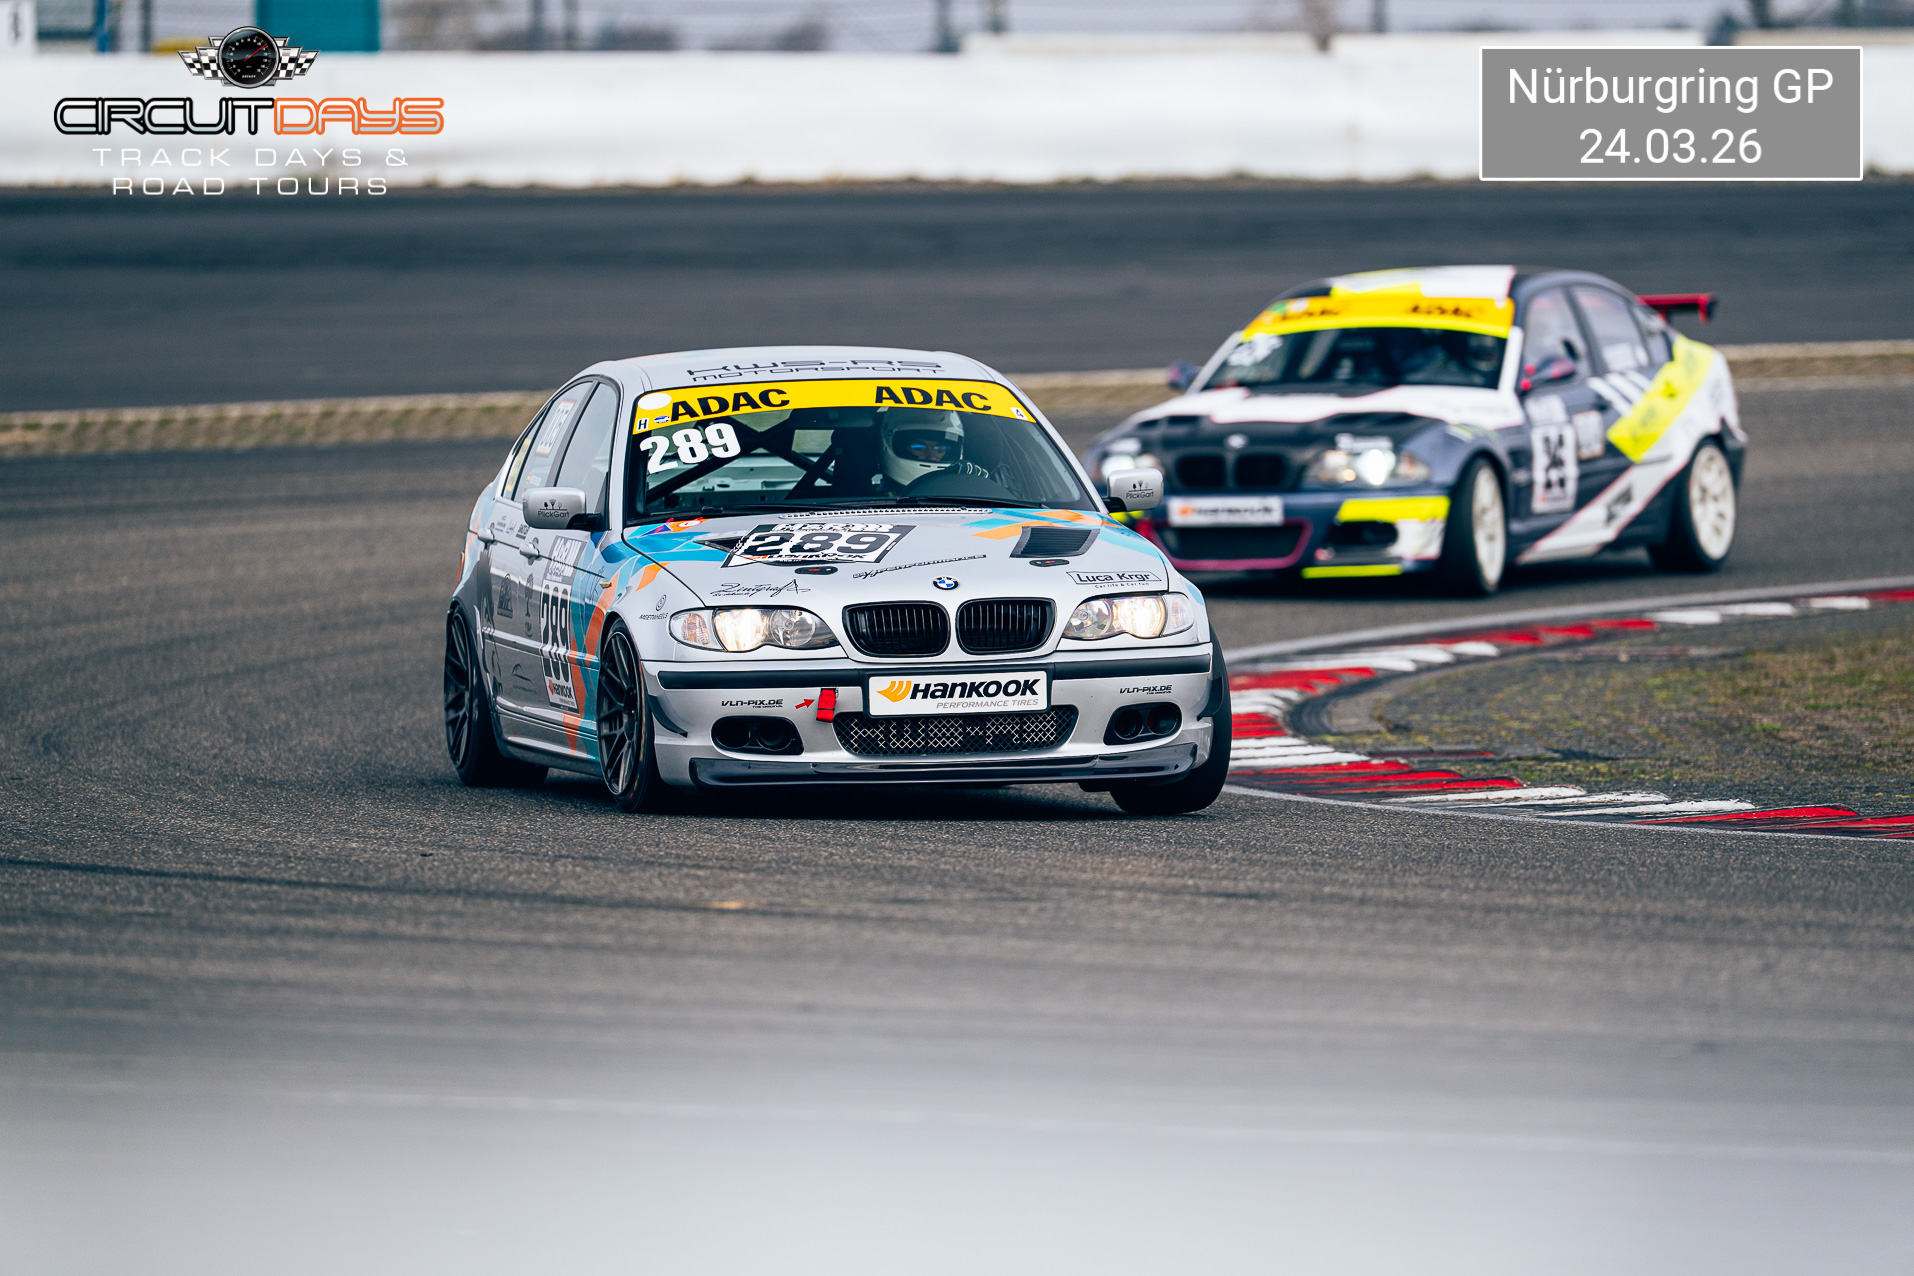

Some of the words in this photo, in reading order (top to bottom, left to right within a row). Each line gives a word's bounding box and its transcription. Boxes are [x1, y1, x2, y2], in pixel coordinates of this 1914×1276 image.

[693, 366, 946, 382] MOTORSPORT
[671, 388, 790, 423] ADAC
[874, 386, 992, 411] ADAC
[638, 418, 648, 430] H
[640, 423, 741, 475] 289
[743, 532, 891, 556] 289
[1076, 573, 1114, 583] Luca
[1116, 573, 1151, 582] Krgr
[541, 584, 572, 683] 289
[936, 700, 1009, 709] PERFORMANCE
[1011, 698, 1039, 706] TIRES
